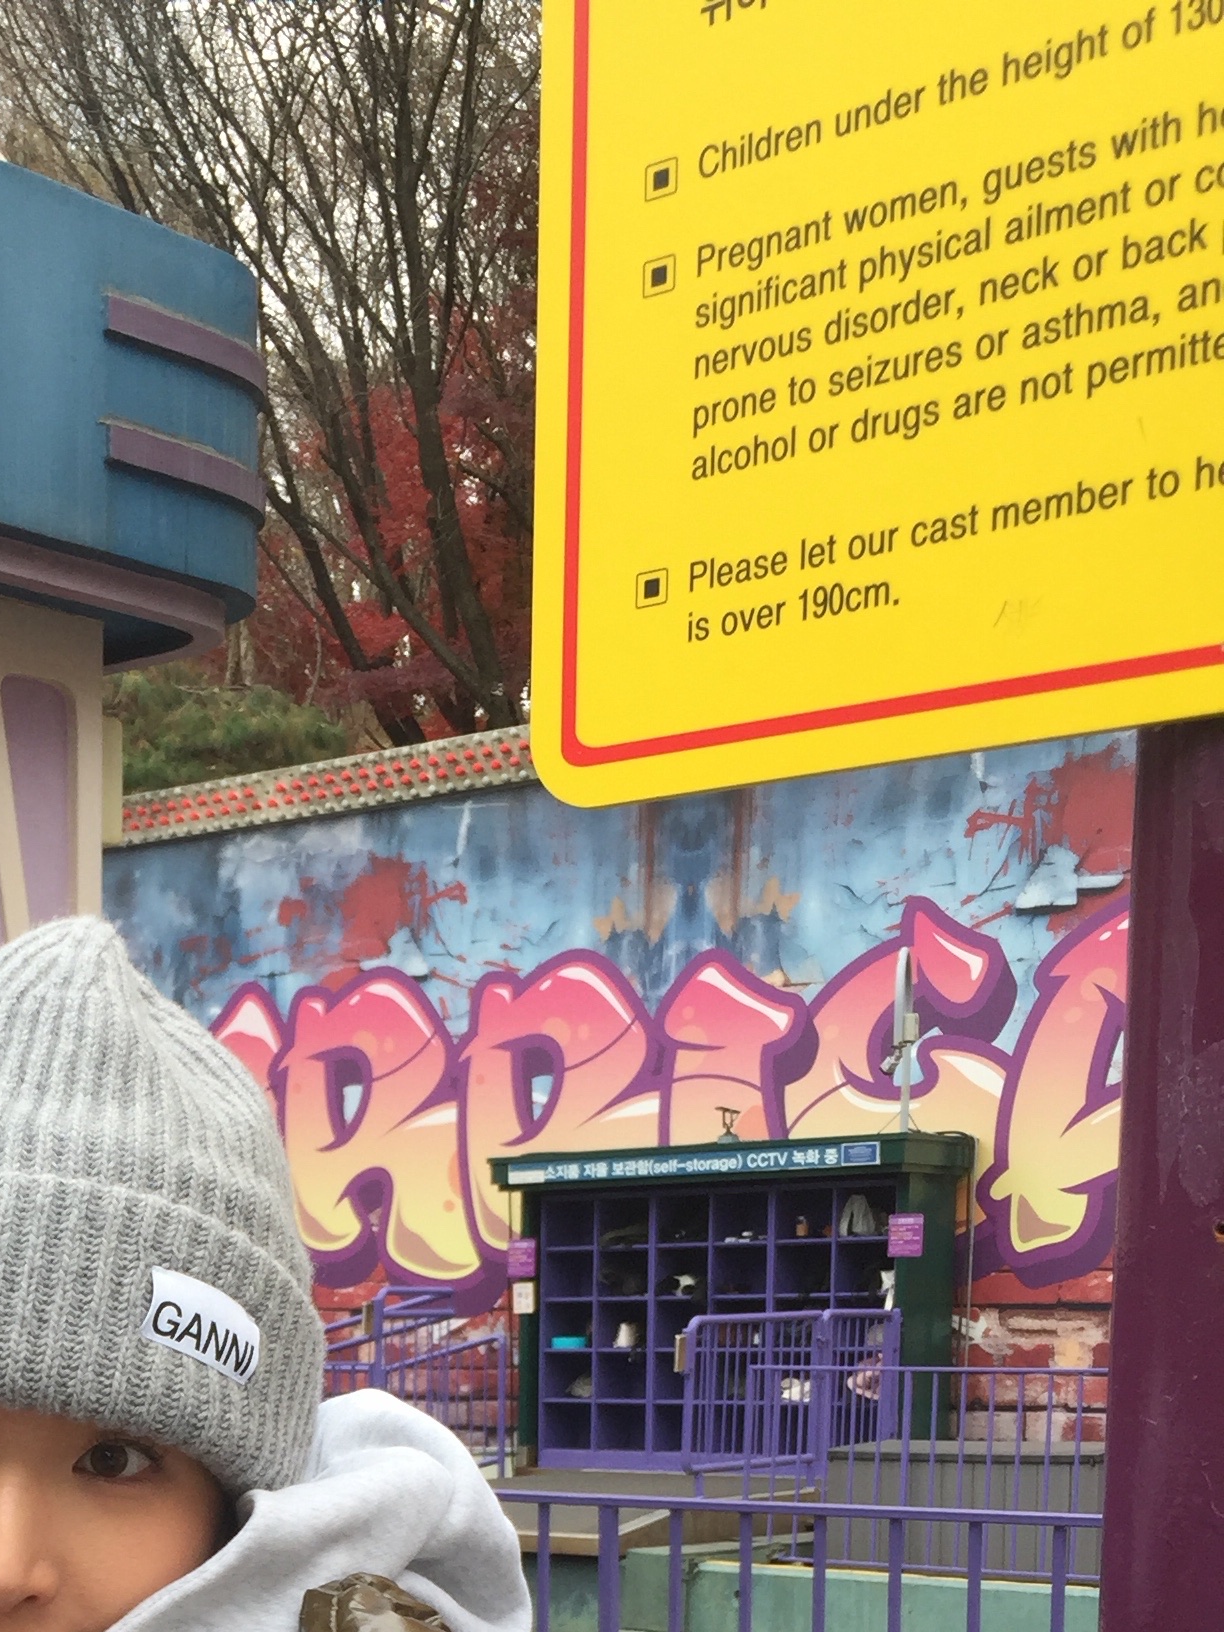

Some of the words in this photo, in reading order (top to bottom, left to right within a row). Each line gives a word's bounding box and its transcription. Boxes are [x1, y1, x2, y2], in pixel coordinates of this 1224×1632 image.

[698, 119, 822, 179] Children
[835, 86, 926, 137] under
[937, 68, 989, 106] the
[1002, 24, 1109, 87] height
[1121, 7, 1156, 50] of
[695, 259, 847, 331] significant
[859, 215, 991, 294] physical
[1004, 181, 1132, 245] ailment
[1144, 173, 1182, 208] or
[696, 210, 832, 278] Pregnant
[843, 180, 968, 235] women,
[982, 140, 1097, 205] guests
[1111, 111, 1182, 160] with
[694, 327, 812, 380] nervous
[824, 288, 964, 346] disorder,
[979, 255, 1060, 306] neck
[1072, 248, 1109, 282] or
[1121, 217, 1208, 270] back
[691, 425, 797, 481] alcohol
[808, 423, 840, 453] or
[850, 400, 940, 444] drugs
[952, 384, 1007, 420] are
[1020, 362, 1074, 405] not
[692, 387, 777, 439] prone
[787, 376, 816, 407] to
[828, 341, 963, 397] seizures
[975, 328, 1010, 361] or
[1021, 295, 1161, 350] asthma,
[689, 550, 788, 593] Please
[800, 534, 837, 571] let
[847, 526, 899, 565] our
[910, 504, 979, 548] cast
[991, 478, 1134, 532] member
[1146, 467, 1180, 501] to
[687, 611, 710, 643] is
[721, 601, 787, 636] over
[798, 581, 900, 622] 190cm.
[746, 1152, 789, 1168] CCTV
[792, 1149, 820, 1165] 녹화
[823, 1148, 838, 1164] 중
[151, 1300, 255, 1377] GANNI
